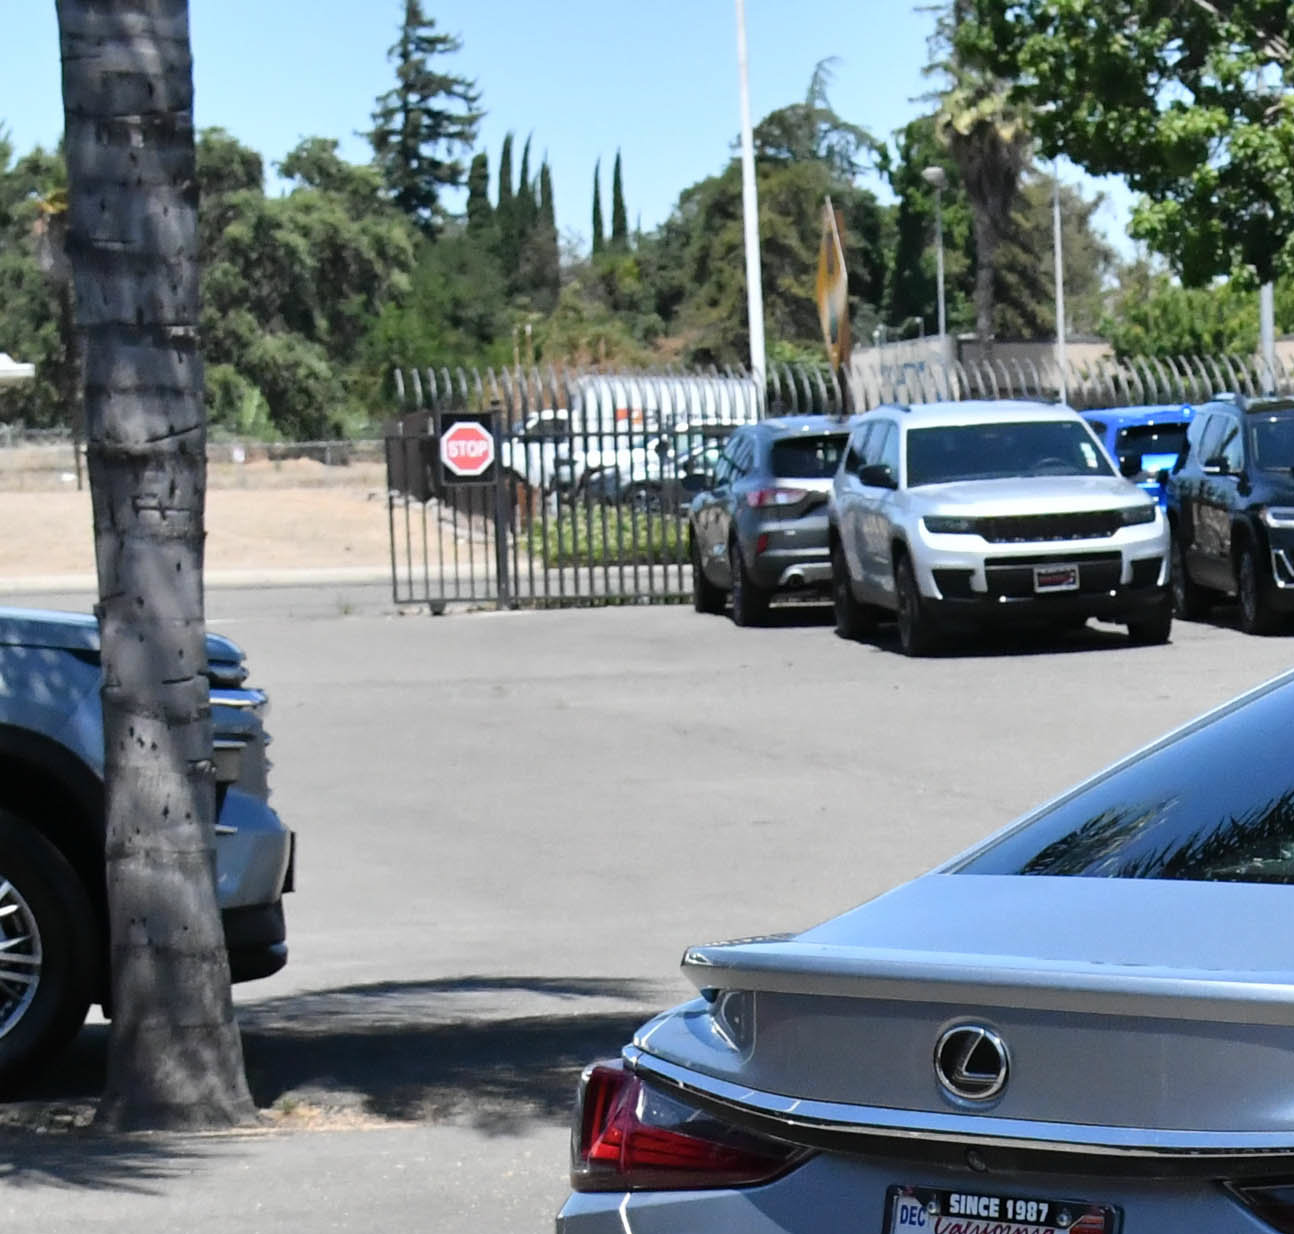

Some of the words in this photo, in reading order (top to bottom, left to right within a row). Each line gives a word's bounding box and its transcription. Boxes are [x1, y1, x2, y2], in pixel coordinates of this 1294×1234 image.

[447, 440, 489, 458] STOP
[900, 1204, 926, 1227] DEC
[949, 1193, 999, 1217] SINCE
[1006, 1199, 1049, 1223] 1987
